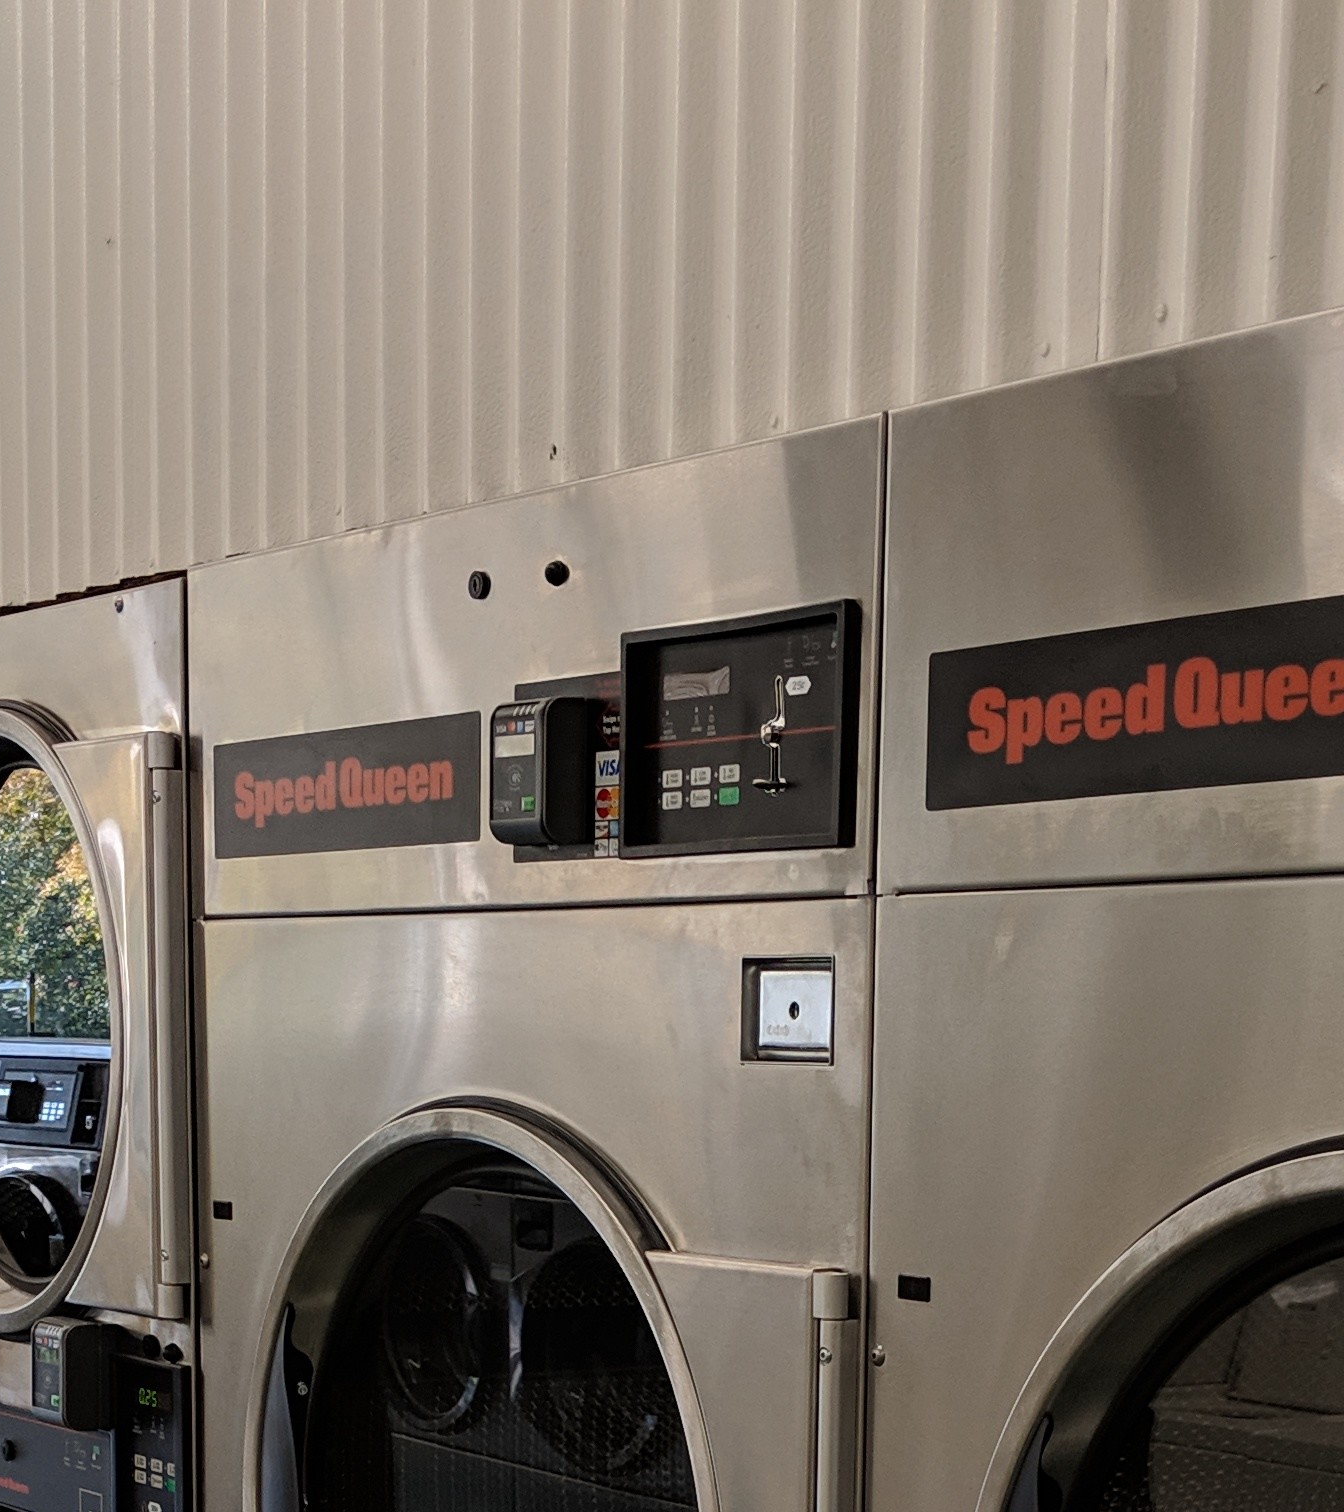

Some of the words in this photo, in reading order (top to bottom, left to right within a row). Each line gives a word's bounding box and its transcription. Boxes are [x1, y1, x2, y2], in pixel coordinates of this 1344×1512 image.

[967, 662, 1167, 766] Speed
[234, 760, 337, 829] Speed
[339, 755, 454, 809] Queen
